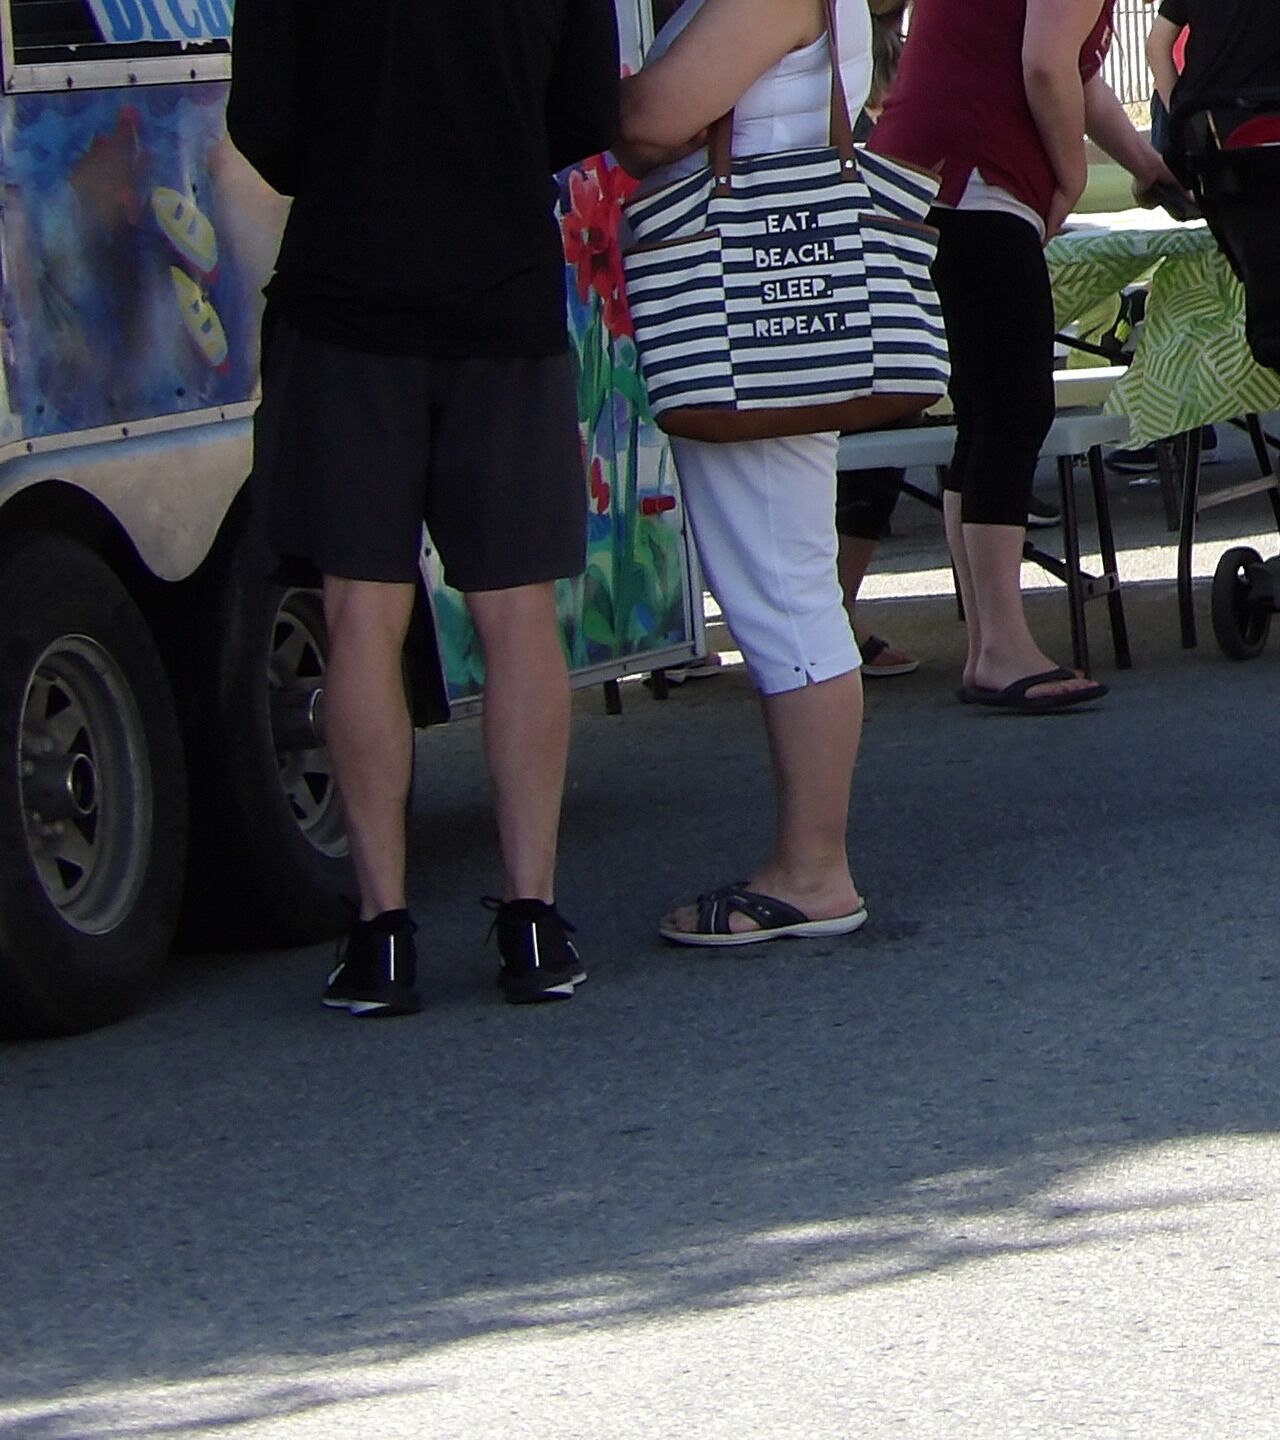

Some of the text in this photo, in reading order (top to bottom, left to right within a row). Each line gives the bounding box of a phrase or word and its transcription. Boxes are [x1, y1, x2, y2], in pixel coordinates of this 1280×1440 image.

[767, 211, 817, 233] EAT.
[755, 242, 835, 269] BEACH.
[763, 278, 832, 301] SLEEP.
[755, 312, 846, 338] REPEAT.
